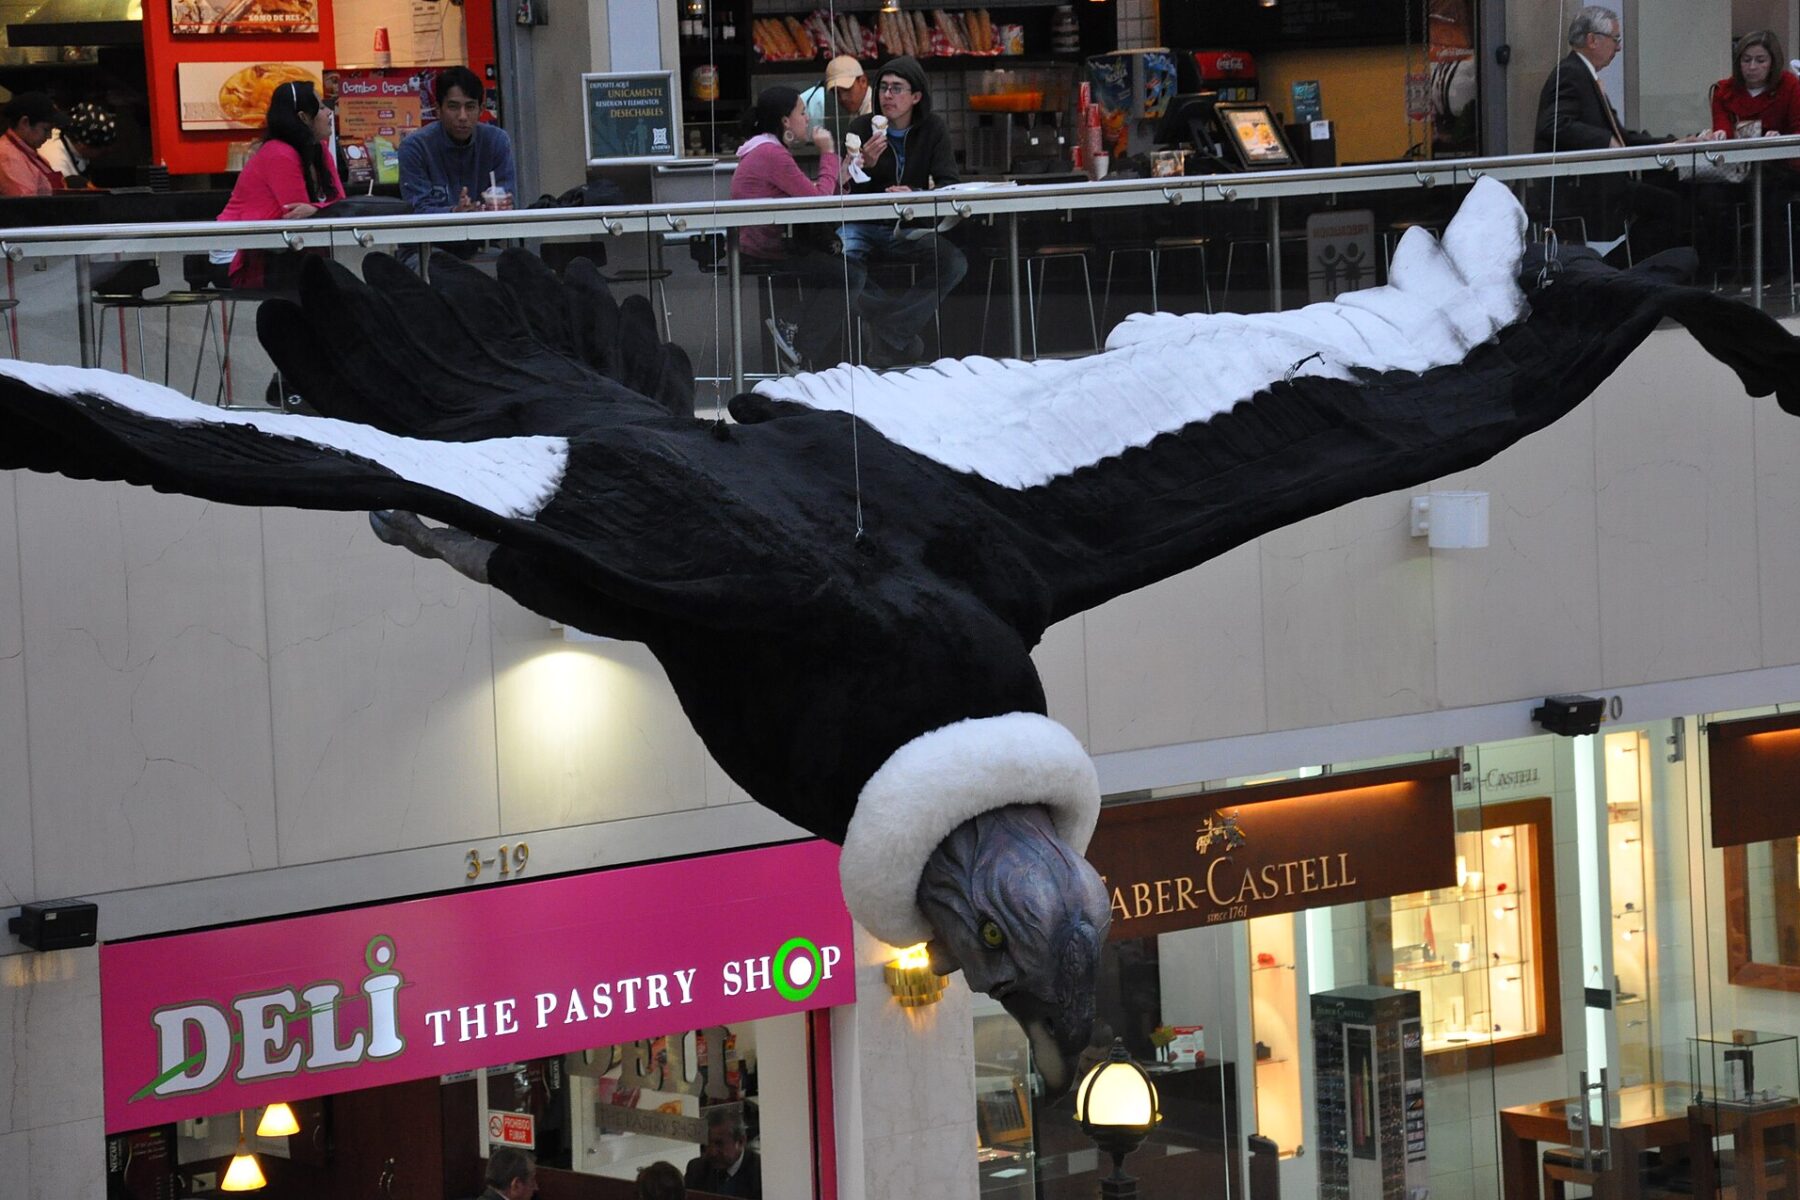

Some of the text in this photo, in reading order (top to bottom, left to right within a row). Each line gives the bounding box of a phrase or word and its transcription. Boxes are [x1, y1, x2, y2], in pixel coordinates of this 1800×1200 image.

[627, 98, 659, 106] ELEMENTOS
[610, 108, 663, 118] DESECHABLES
[465, 842, 530, 879] 3-19
[1207, 905, 1248, 923] since 1761
[425, 937, 841, 1047] THE PASTRY SHOP
[504, 1116, 530, 1130] PROHIBIDO
